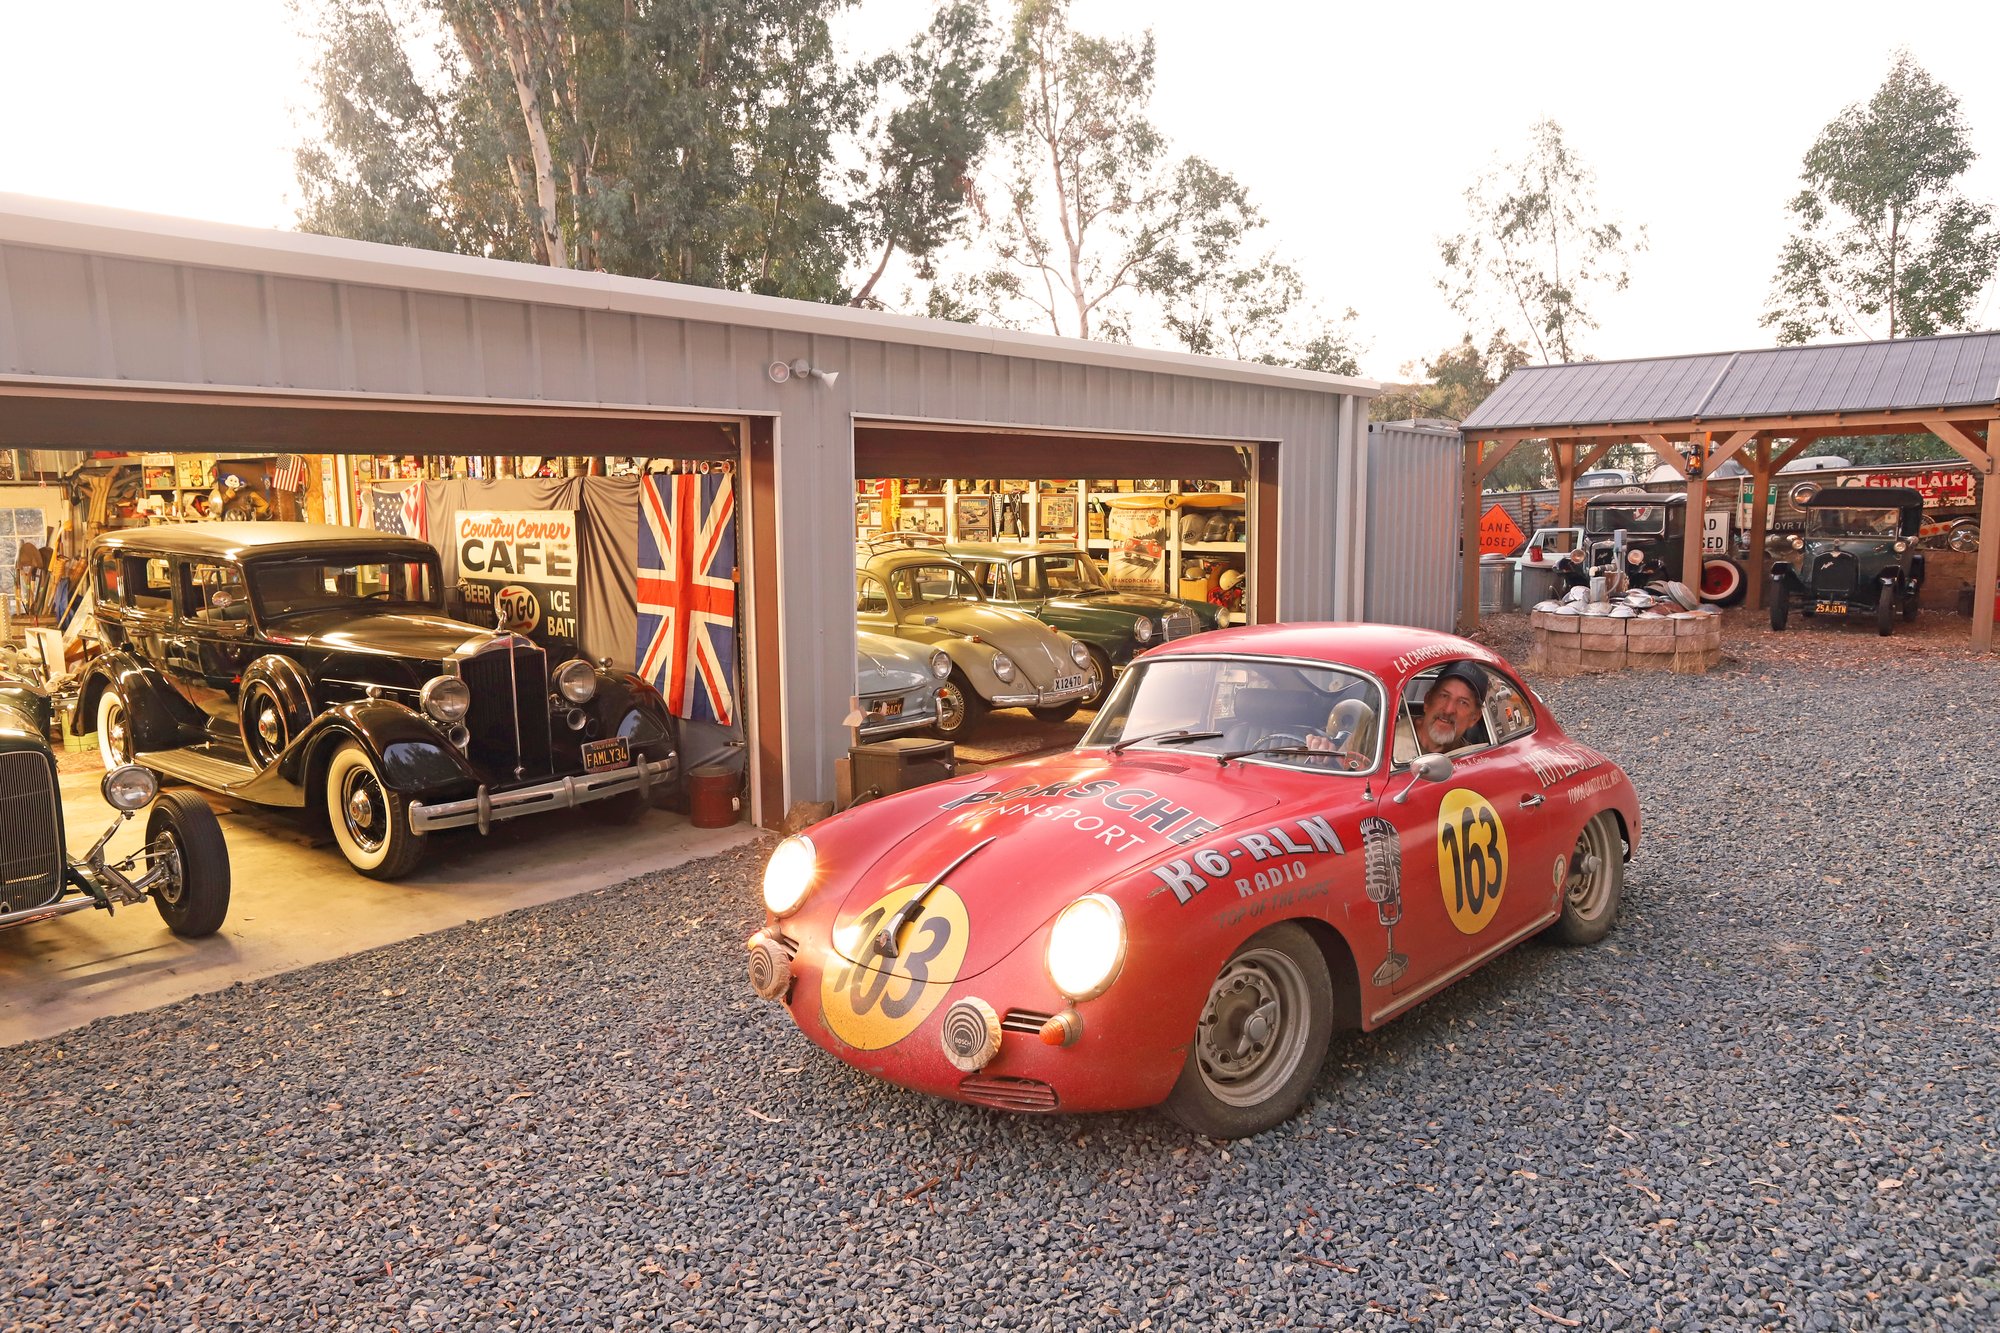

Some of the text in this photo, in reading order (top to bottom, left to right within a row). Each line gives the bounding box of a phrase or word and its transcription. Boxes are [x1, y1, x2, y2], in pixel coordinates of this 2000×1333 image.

[1869, 474, 1964, 488] SINCLAIR
[461, 517, 571, 546] Country Corner
[1480, 522, 1511, 533] LANE
[1480, 536, 1516, 548] LOSED
[461, 538, 572, 577] CAFE
[464, 583, 492, 604] BEER
[516, 595, 536, 620] GO
[549, 590, 571, 612] ICE
[547, 616, 576, 638] BAIT
[1393, 656, 1415, 674] LA
[1406, 643, 1452, 666] CARRERA
[1522, 746, 1579, 790] HOTEL
[939, 780, 1223, 847] PORSCHE
[948, 803, 1146, 852] RENNSPORT
[1151, 815, 1346, 905] K6-RLN
[1441, 806, 1503, 915] 163
[1234, 860, 1308, 898] RADIO
[834, 906, 952, 1019] 163
[954, 1037, 972, 1047] BOSCH
